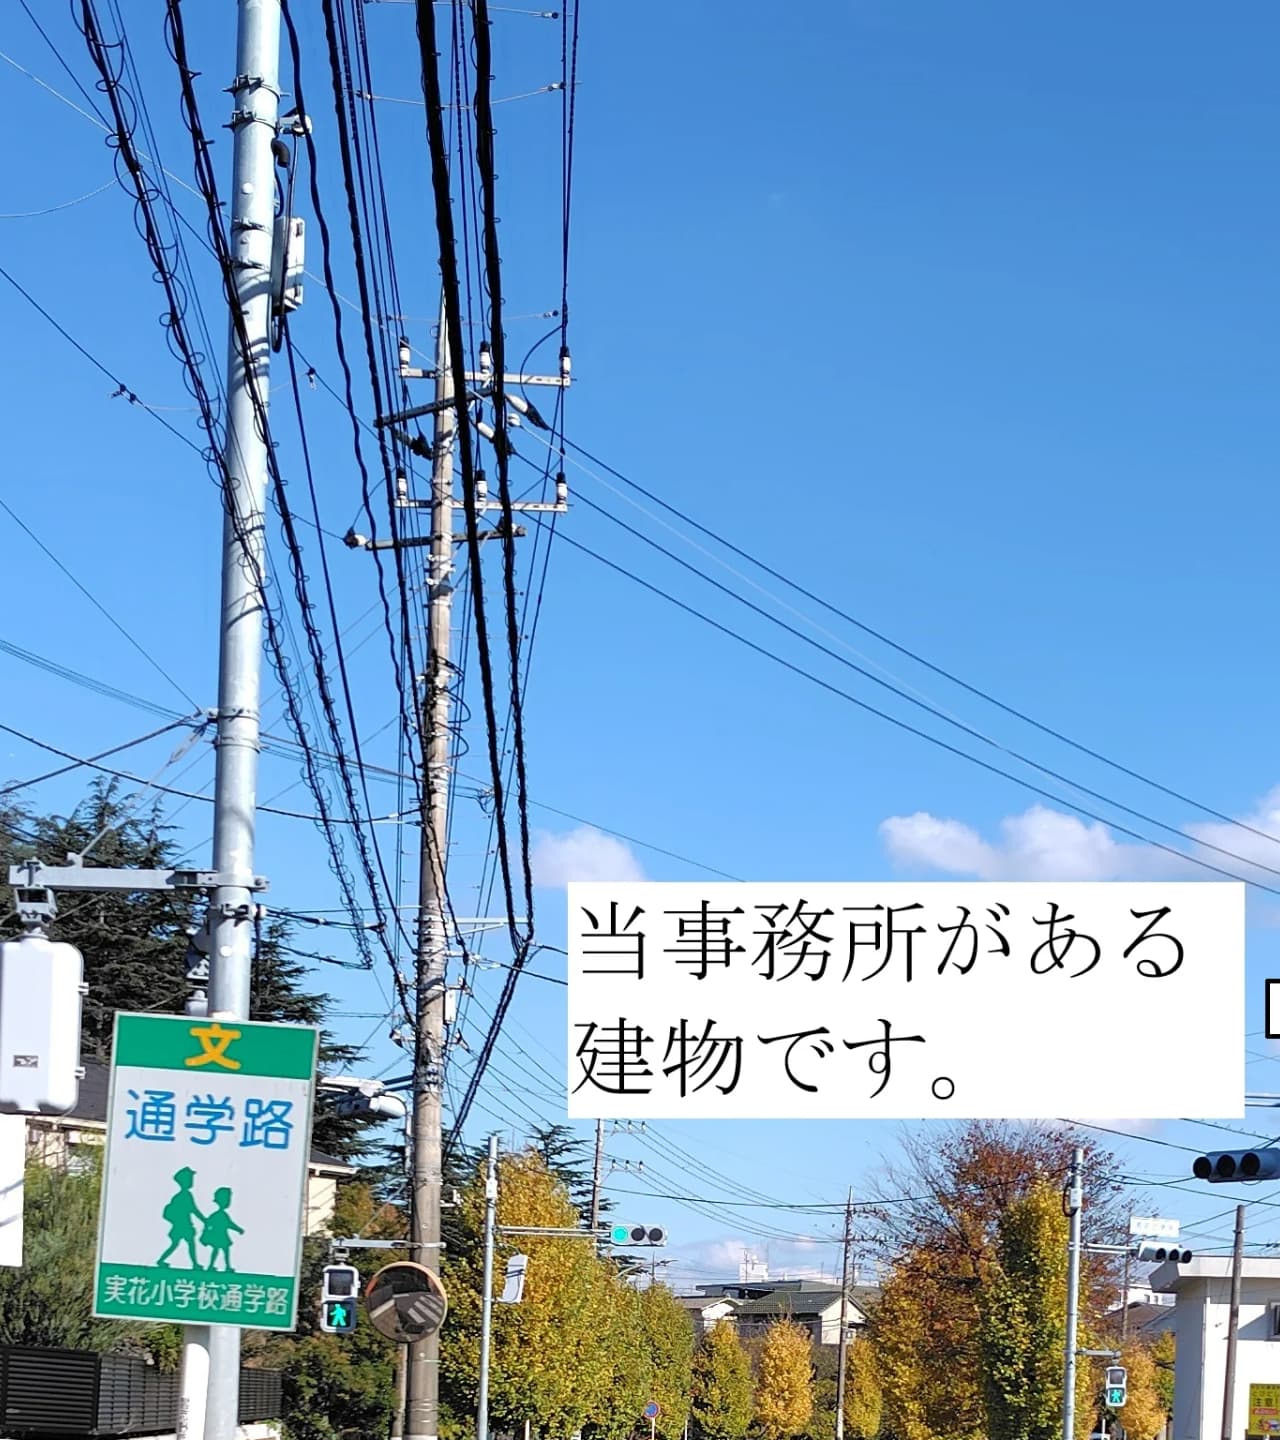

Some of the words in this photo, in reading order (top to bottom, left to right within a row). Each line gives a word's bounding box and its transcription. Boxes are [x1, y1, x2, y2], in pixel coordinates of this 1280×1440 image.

[186, 1024, 241, 1070] 文
[124, 1089, 294, 1151] 通学路
[104, 1274, 289, 1315] 実花小学校通学路
